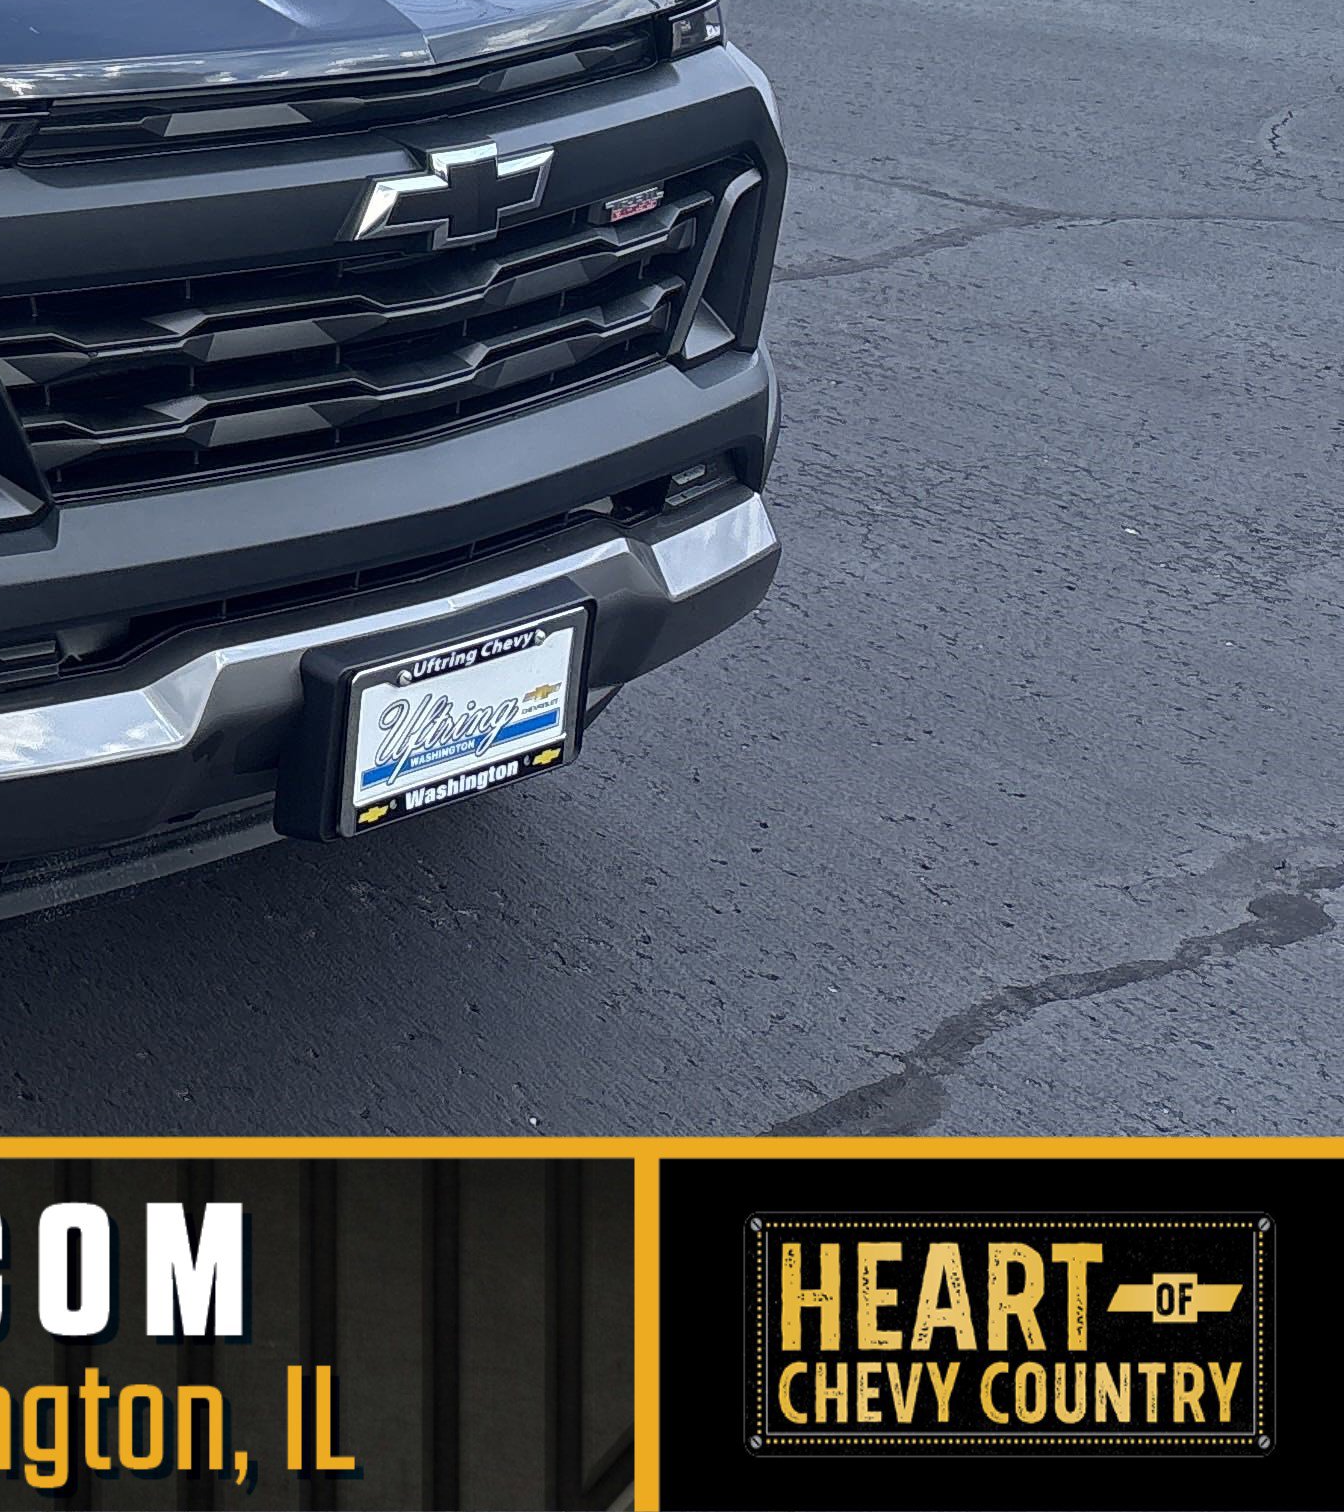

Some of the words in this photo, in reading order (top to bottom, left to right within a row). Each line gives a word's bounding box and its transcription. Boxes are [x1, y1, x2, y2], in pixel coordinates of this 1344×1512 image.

[412, 647, 479, 678] Uftring
[480, 631, 534, 659] Chevy
[374, 693, 519, 784] Uftring
[410, 740, 475, 768] WASHINGTON
[405, 759, 519, 811] Washington
